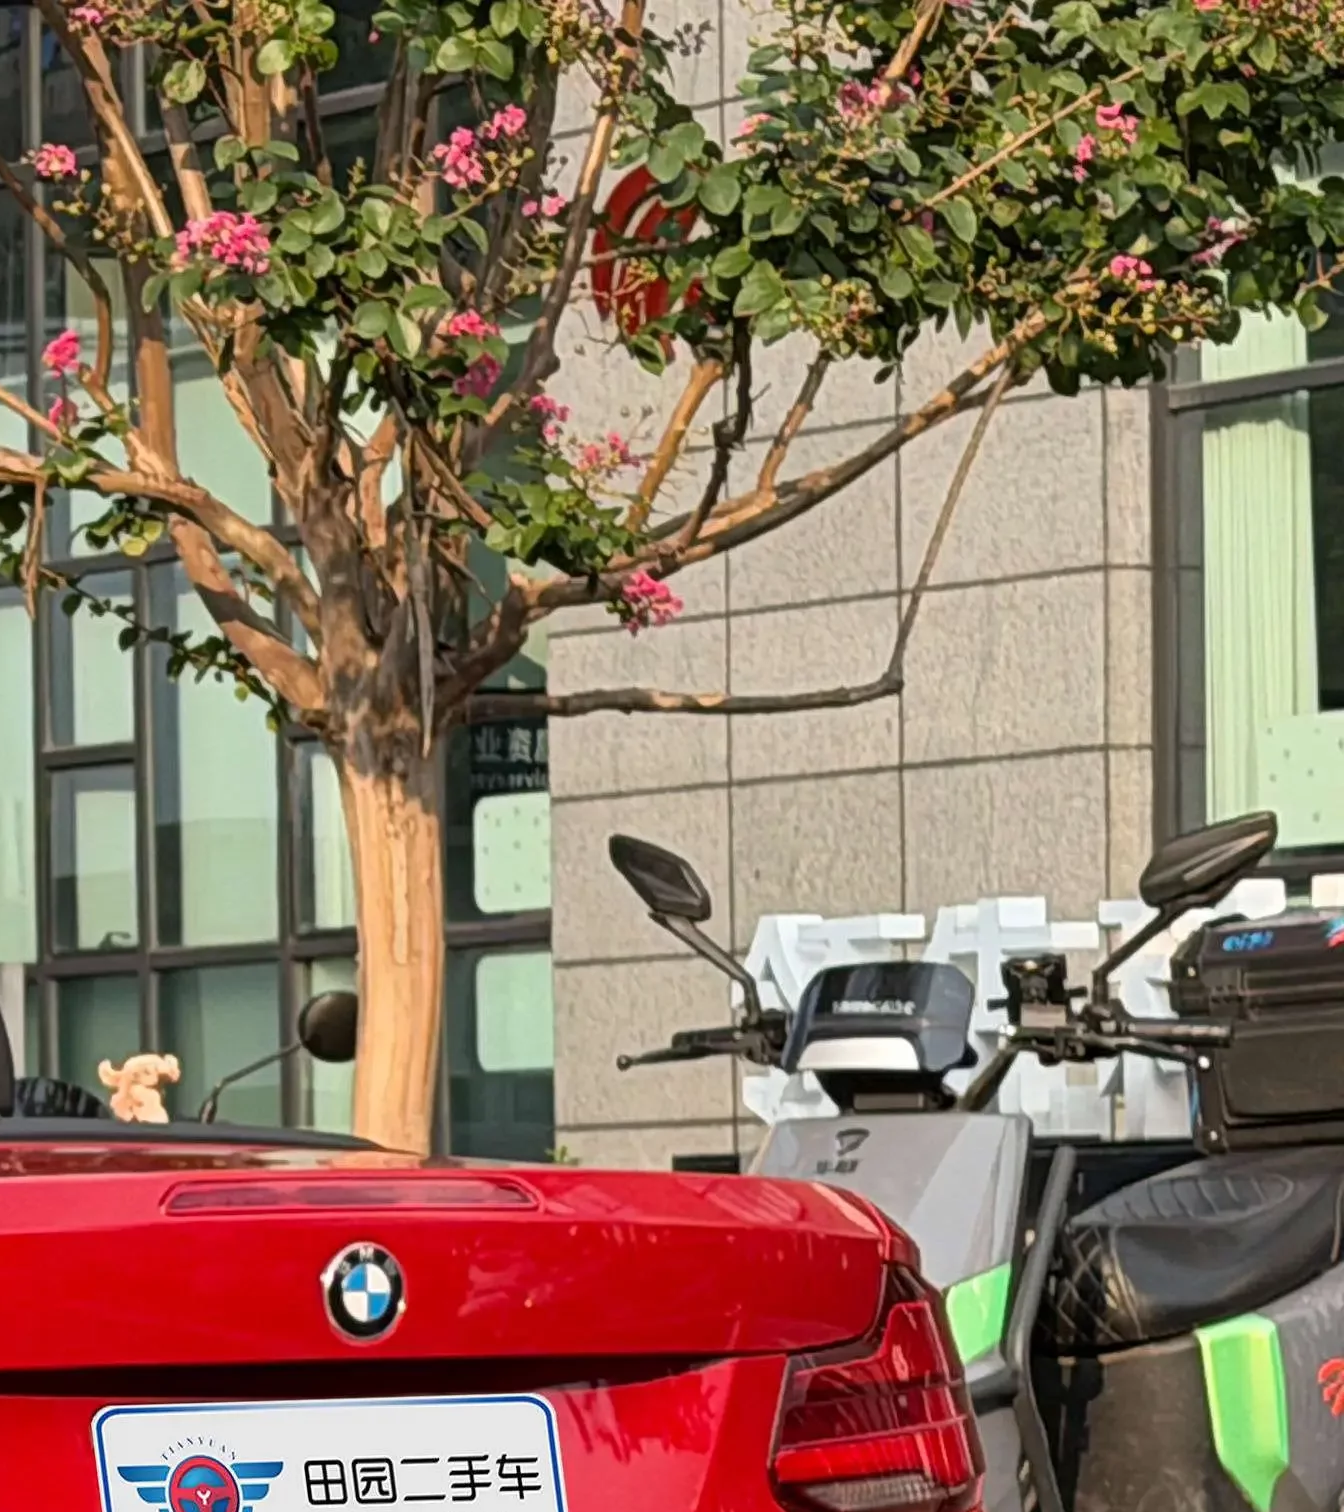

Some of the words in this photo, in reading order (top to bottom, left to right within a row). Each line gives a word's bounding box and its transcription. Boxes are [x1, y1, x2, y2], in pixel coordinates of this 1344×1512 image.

[303, 1453, 543, 1505] 田园二手车
